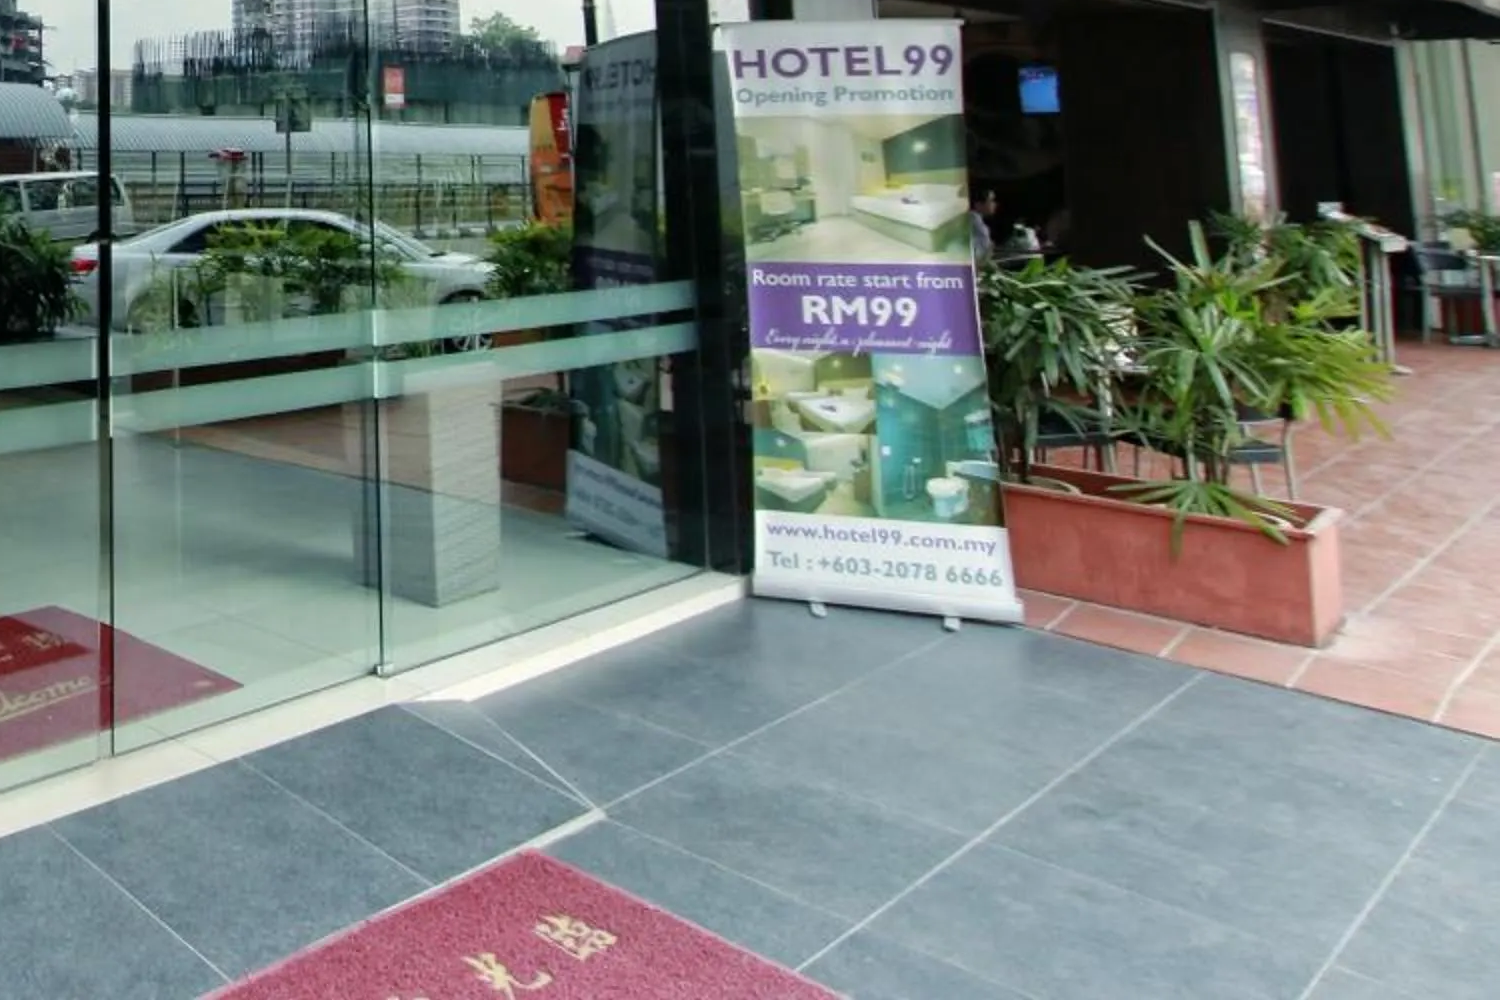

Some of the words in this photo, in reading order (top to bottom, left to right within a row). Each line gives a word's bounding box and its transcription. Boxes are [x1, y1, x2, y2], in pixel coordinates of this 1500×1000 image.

[733, 44, 953, 79] HOTEL99
[736, 86, 828, 107] Opening
[833, 85, 954, 102] Promotion
[752, 269, 811, 287] Room
[817, 273, 858, 288] rate
[863, 273, 911, 289] start
[916, 271, 964, 289] from
[801, 295, 918, 327] RM99
[766, 522, 997, 556] www.hotel99.com.my
[768, 550, 800, 570] Tel
[818, 557, 938, 582] +603-2078
[945, 564, 1004, 588] 6666
